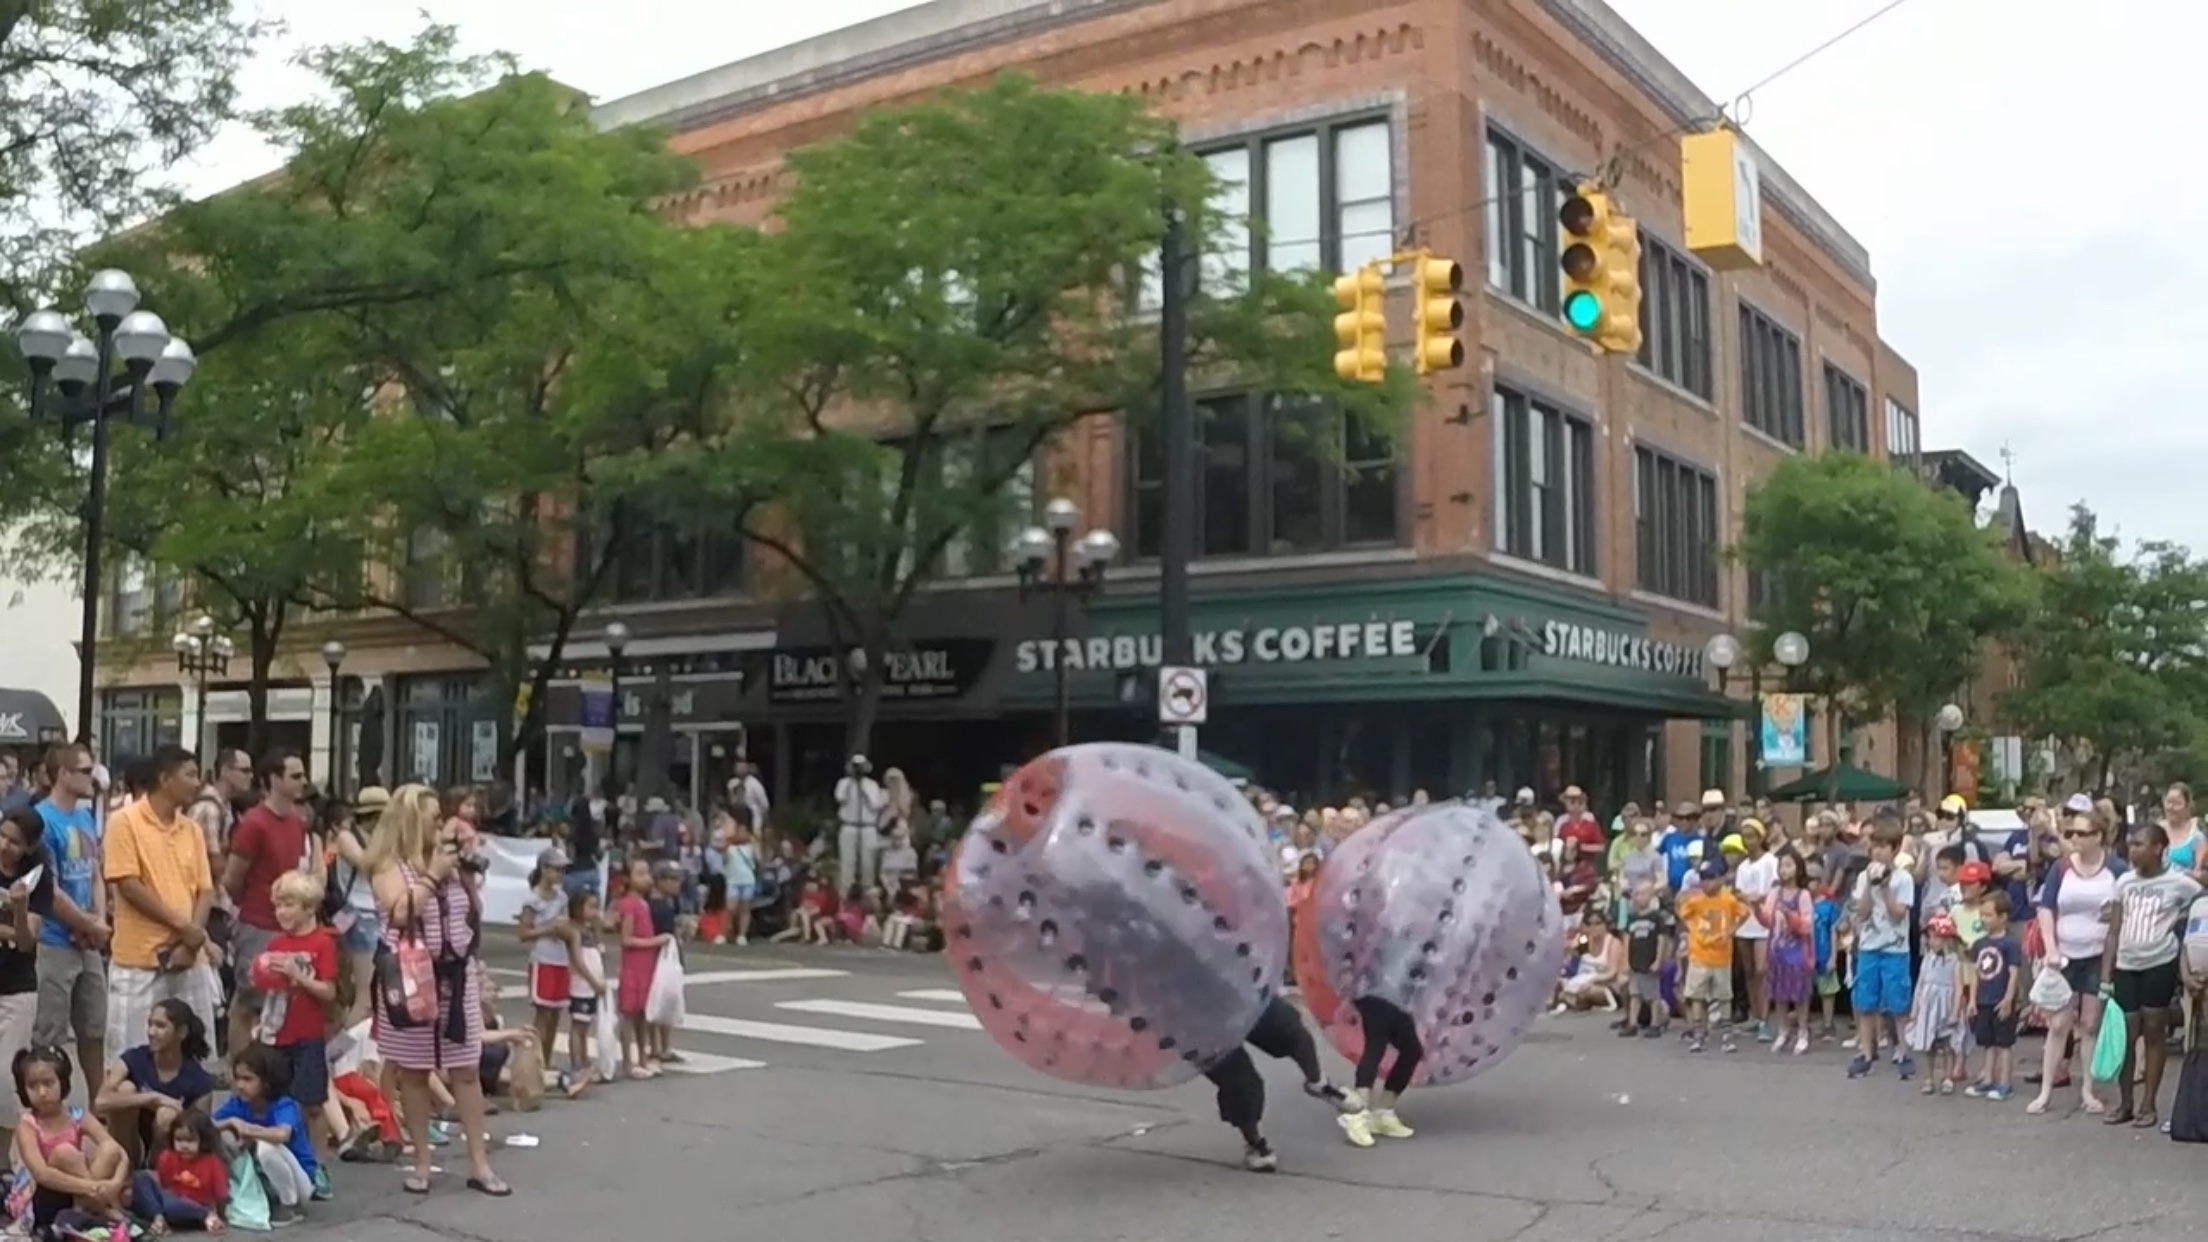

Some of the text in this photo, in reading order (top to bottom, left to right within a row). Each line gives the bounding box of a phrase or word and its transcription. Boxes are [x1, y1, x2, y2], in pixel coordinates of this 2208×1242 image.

[1016, 620, 1416, 672] STARBUKS COFFEE
[1545, 619, 1650, 669] STARBUCKS
